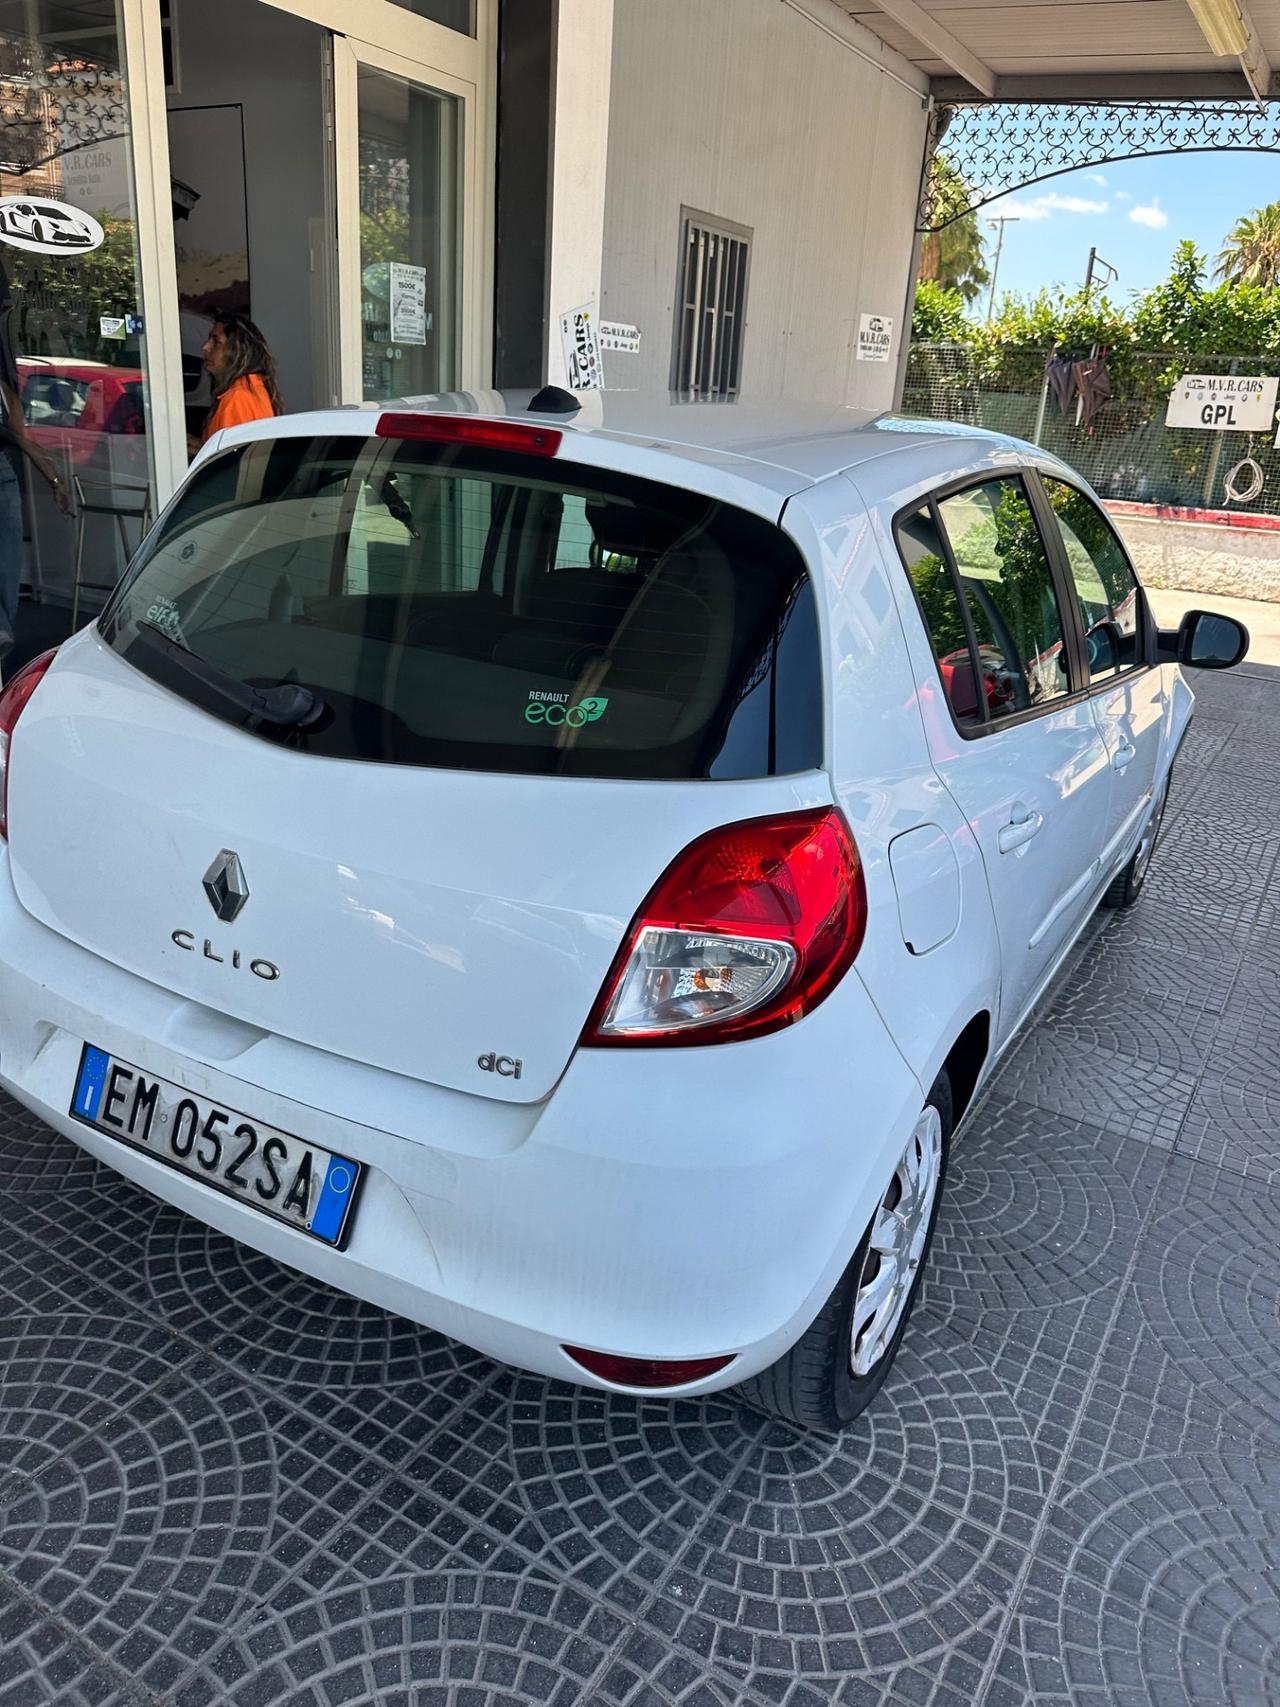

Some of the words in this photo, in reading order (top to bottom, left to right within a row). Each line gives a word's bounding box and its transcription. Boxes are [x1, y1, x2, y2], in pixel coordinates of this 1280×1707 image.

[1208, 379, 1265, 393] M.V.R.CARS
[1201, 404, 1237, 425] GPL
[528, 690, 570, 703] RENAULT
[171, 929, 280, 980] CLIO
